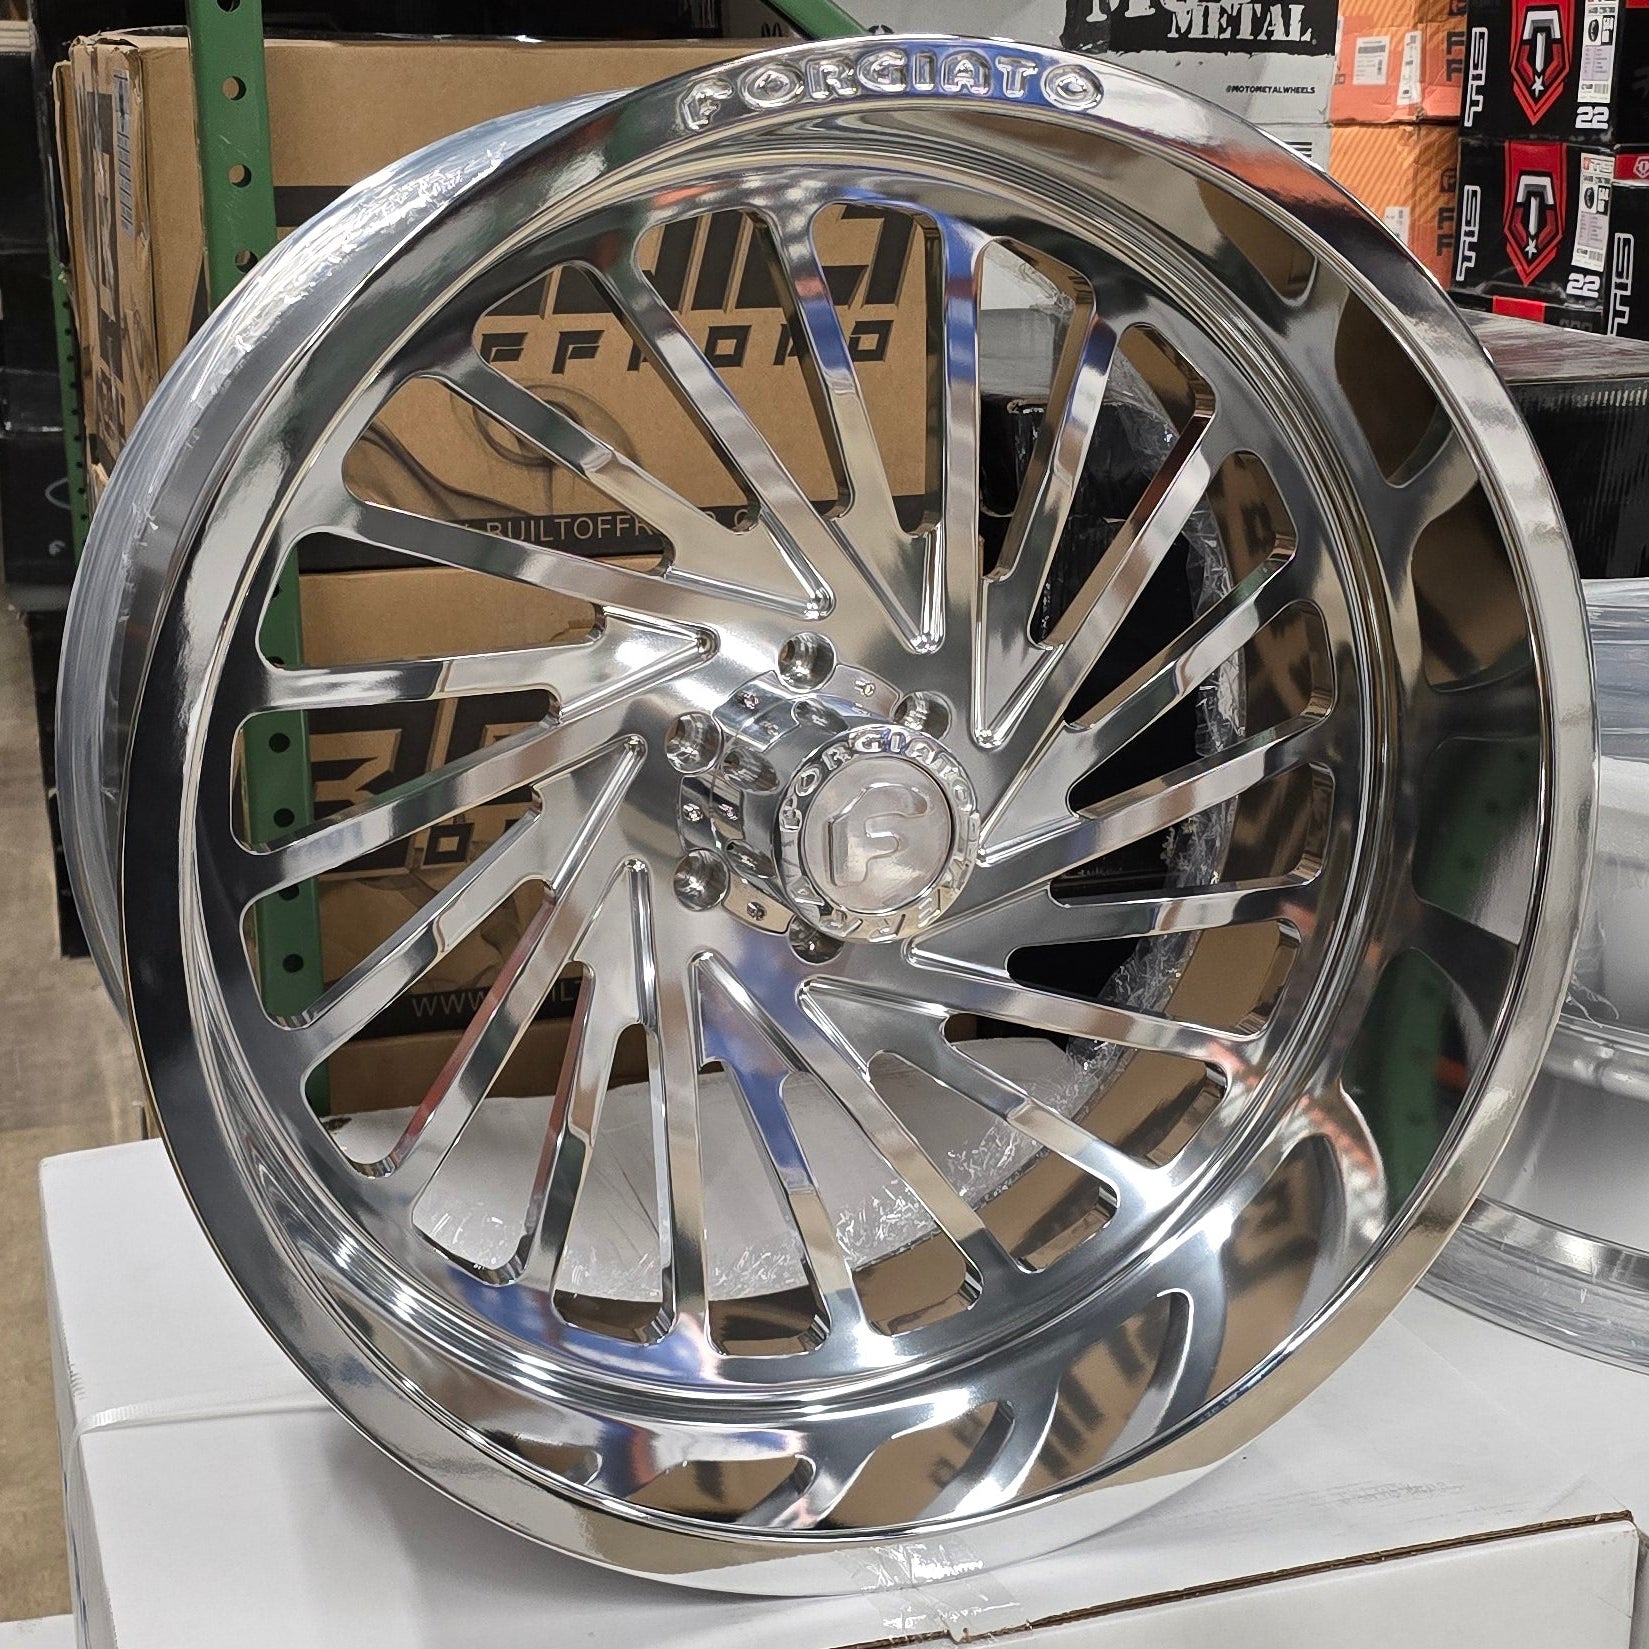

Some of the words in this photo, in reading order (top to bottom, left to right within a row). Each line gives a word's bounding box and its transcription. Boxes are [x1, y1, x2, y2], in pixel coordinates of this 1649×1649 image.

[1167, 3, 1312, 42] METAL
[680, 49, 1104, 132] FORGIATO
[1225, 85, 1316, 95] @MOTOMETALWHEELS
[1464, 27, 1488, 127] TIS
[1575, 106, 1609, 129] 22
[1456, 185, 1481, 281] TIS
[1566, 272, 1600, 298] 22
[779, 728, 975, 832] FORGIATO
